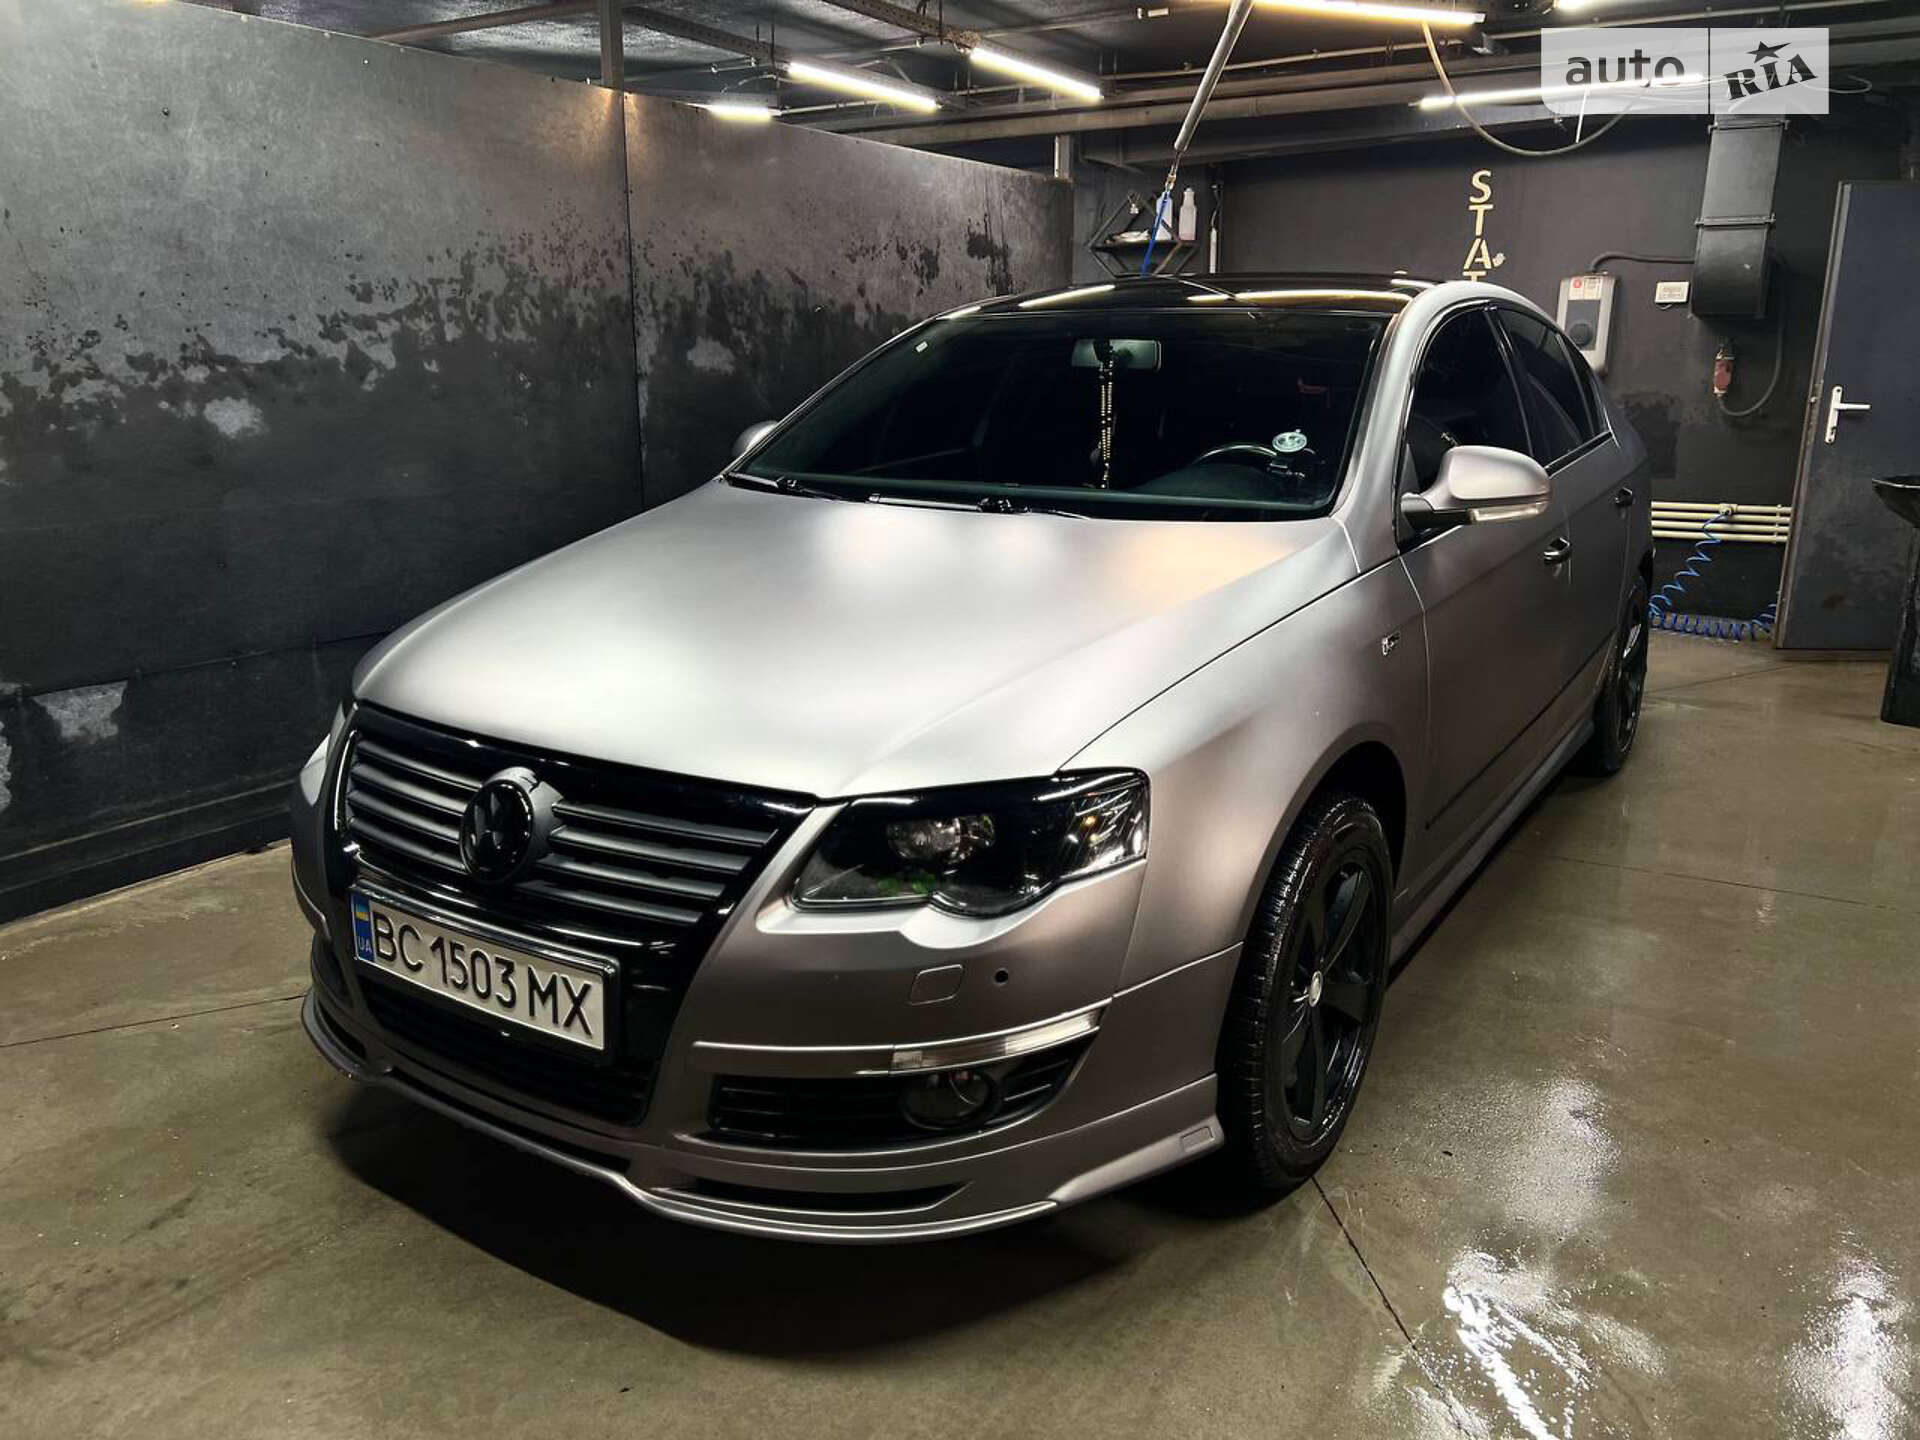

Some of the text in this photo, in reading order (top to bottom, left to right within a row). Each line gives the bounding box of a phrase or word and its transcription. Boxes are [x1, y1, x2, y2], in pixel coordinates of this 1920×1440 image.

[373, 910, 592, 1038] BC 1503 MX
